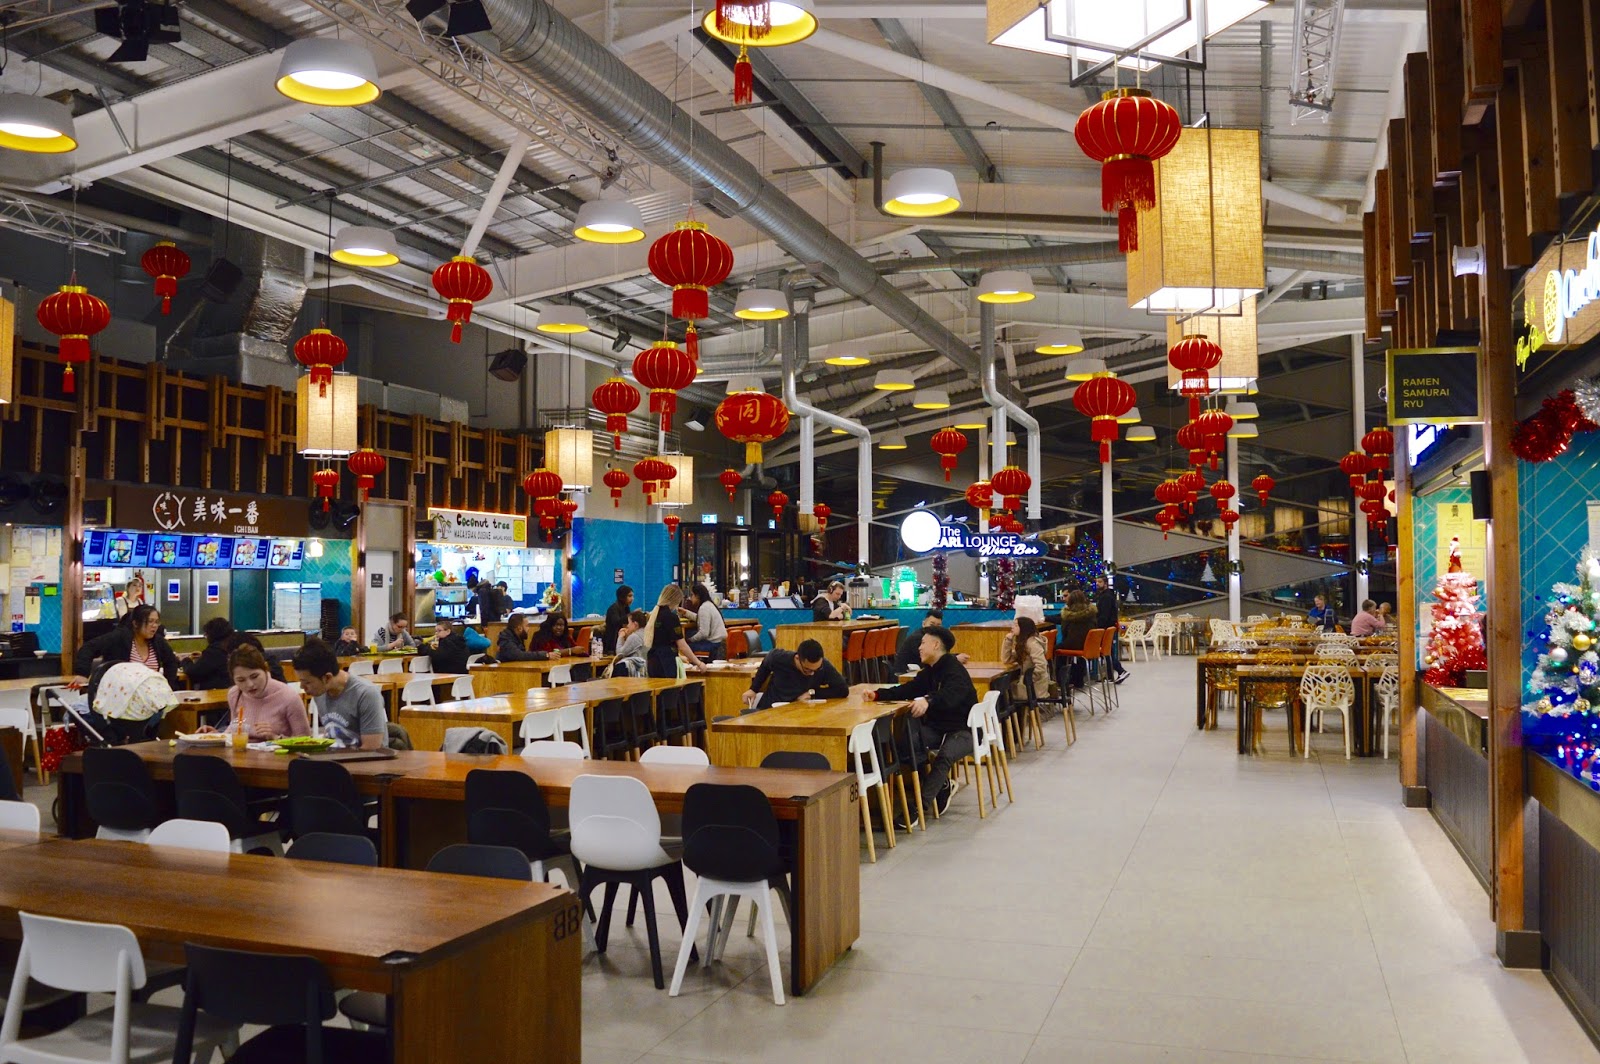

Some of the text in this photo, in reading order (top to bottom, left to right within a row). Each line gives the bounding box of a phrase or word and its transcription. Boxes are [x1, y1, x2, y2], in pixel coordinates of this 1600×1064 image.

[1402, 377, 1440, 387] RAMEN
[1403, 388, 1450, 398] SAMURAI
[1403, 400, 1424, 408] RYU
[193, 496, 259, 524] 美味一番
[457, 513, 510, 529] Coconut tree
[233, 525, 259, 534] ICHIBAN
[940, 526, 961, 537] The
[965, 535, 1016, 548] LOUNGE
[1013, 543, 1039, 555] Bar
